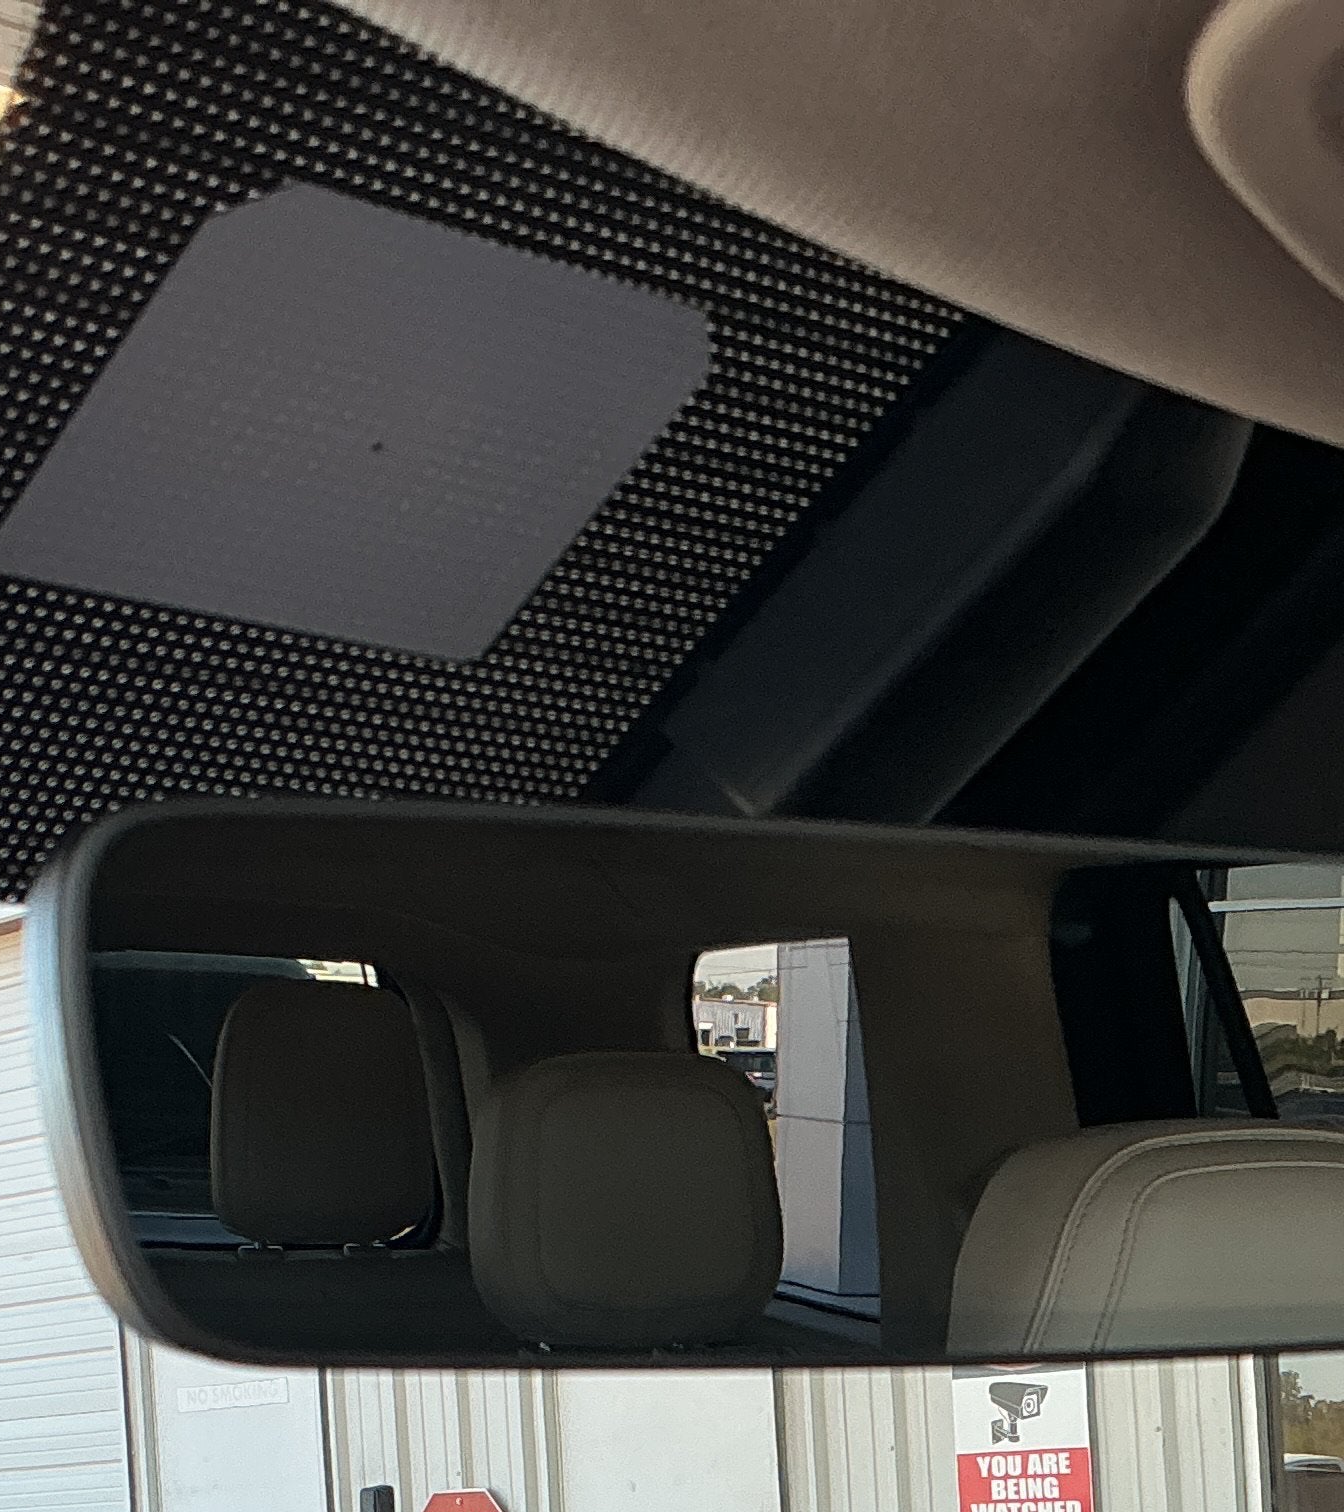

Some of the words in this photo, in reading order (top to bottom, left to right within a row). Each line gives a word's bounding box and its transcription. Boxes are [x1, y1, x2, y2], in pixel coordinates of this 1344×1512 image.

[186, 1388, 208, 1405] NO
[976, 1455, 1022, 1477] YOU
[1027, 1453, 1071, 1475] ARE
[990, 1477, 1060, 1500] BEING
